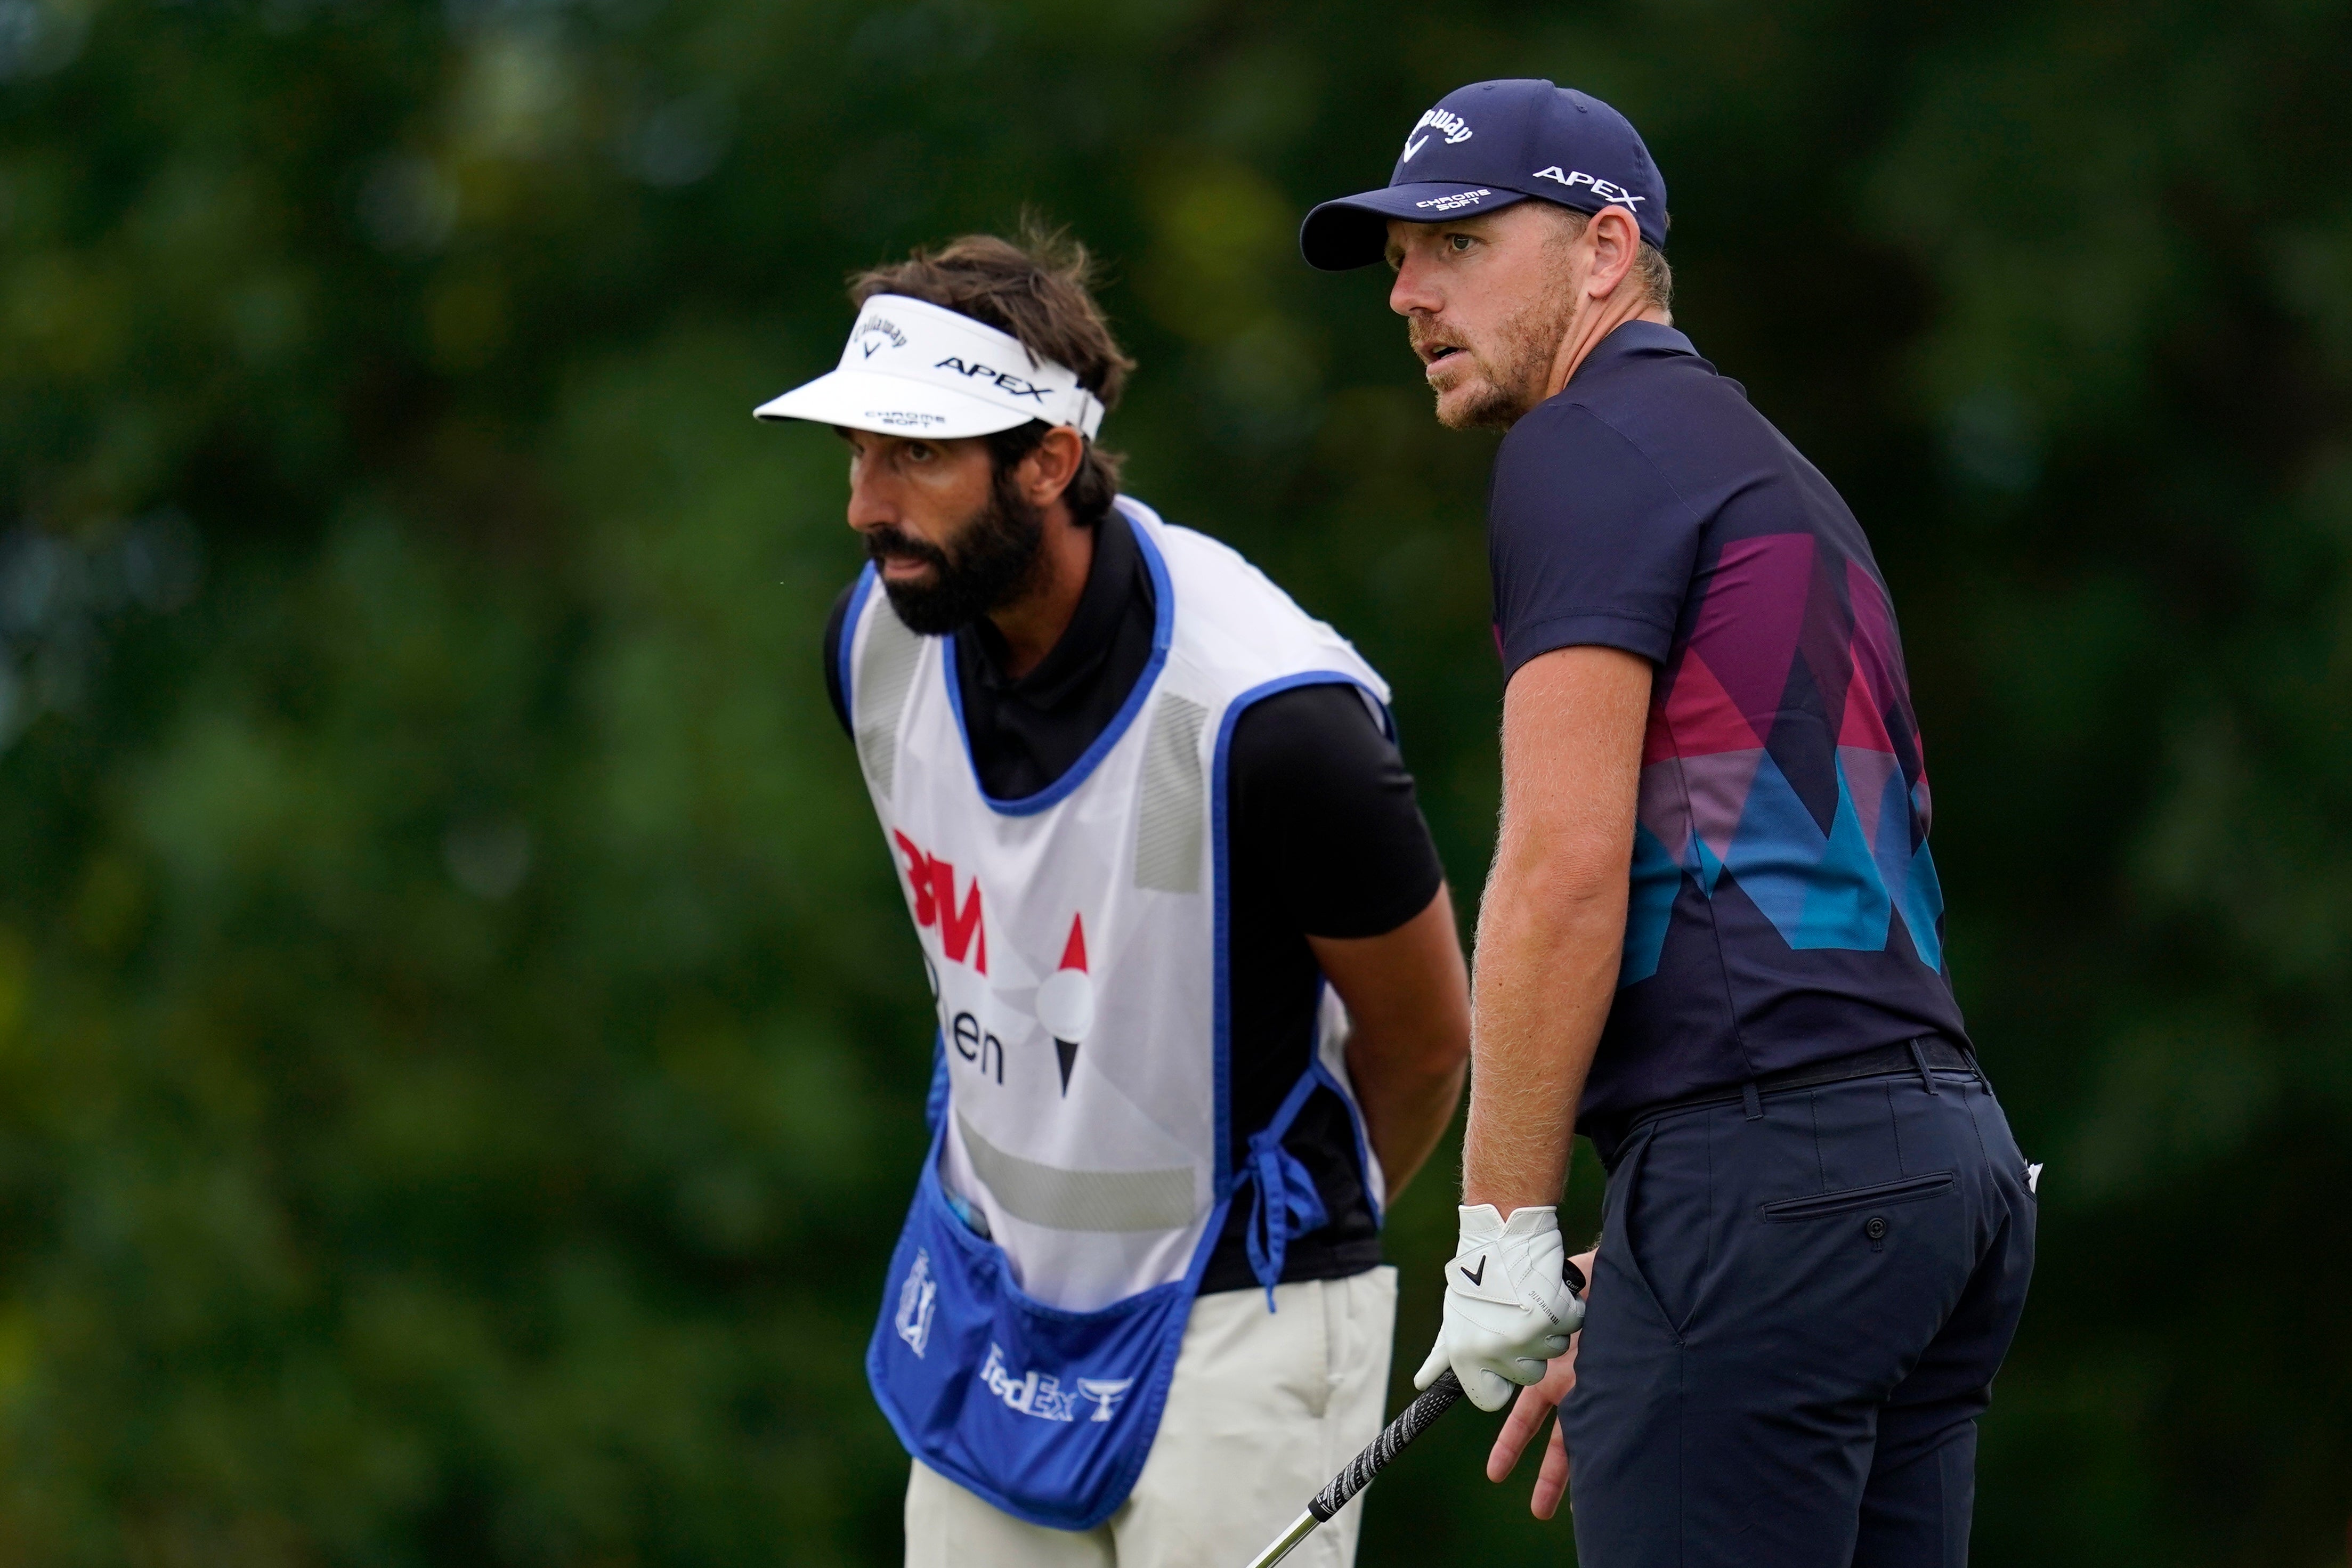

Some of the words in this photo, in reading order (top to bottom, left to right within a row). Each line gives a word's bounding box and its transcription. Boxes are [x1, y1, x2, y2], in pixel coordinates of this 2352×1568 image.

[1416, 189, 1491, 208] CHROME
[1436, 197, 1479, 211] SOFT
[1532, 166, 1646, 213] APEX
[934, 357, 1055, 404] APEX
[865, 411, 945, 424] CHROME
[882, 418, 929, 428] SOFT
[893, 826, 987, 978] 3M
[979, 1342, 1078, 1422] FedEx
